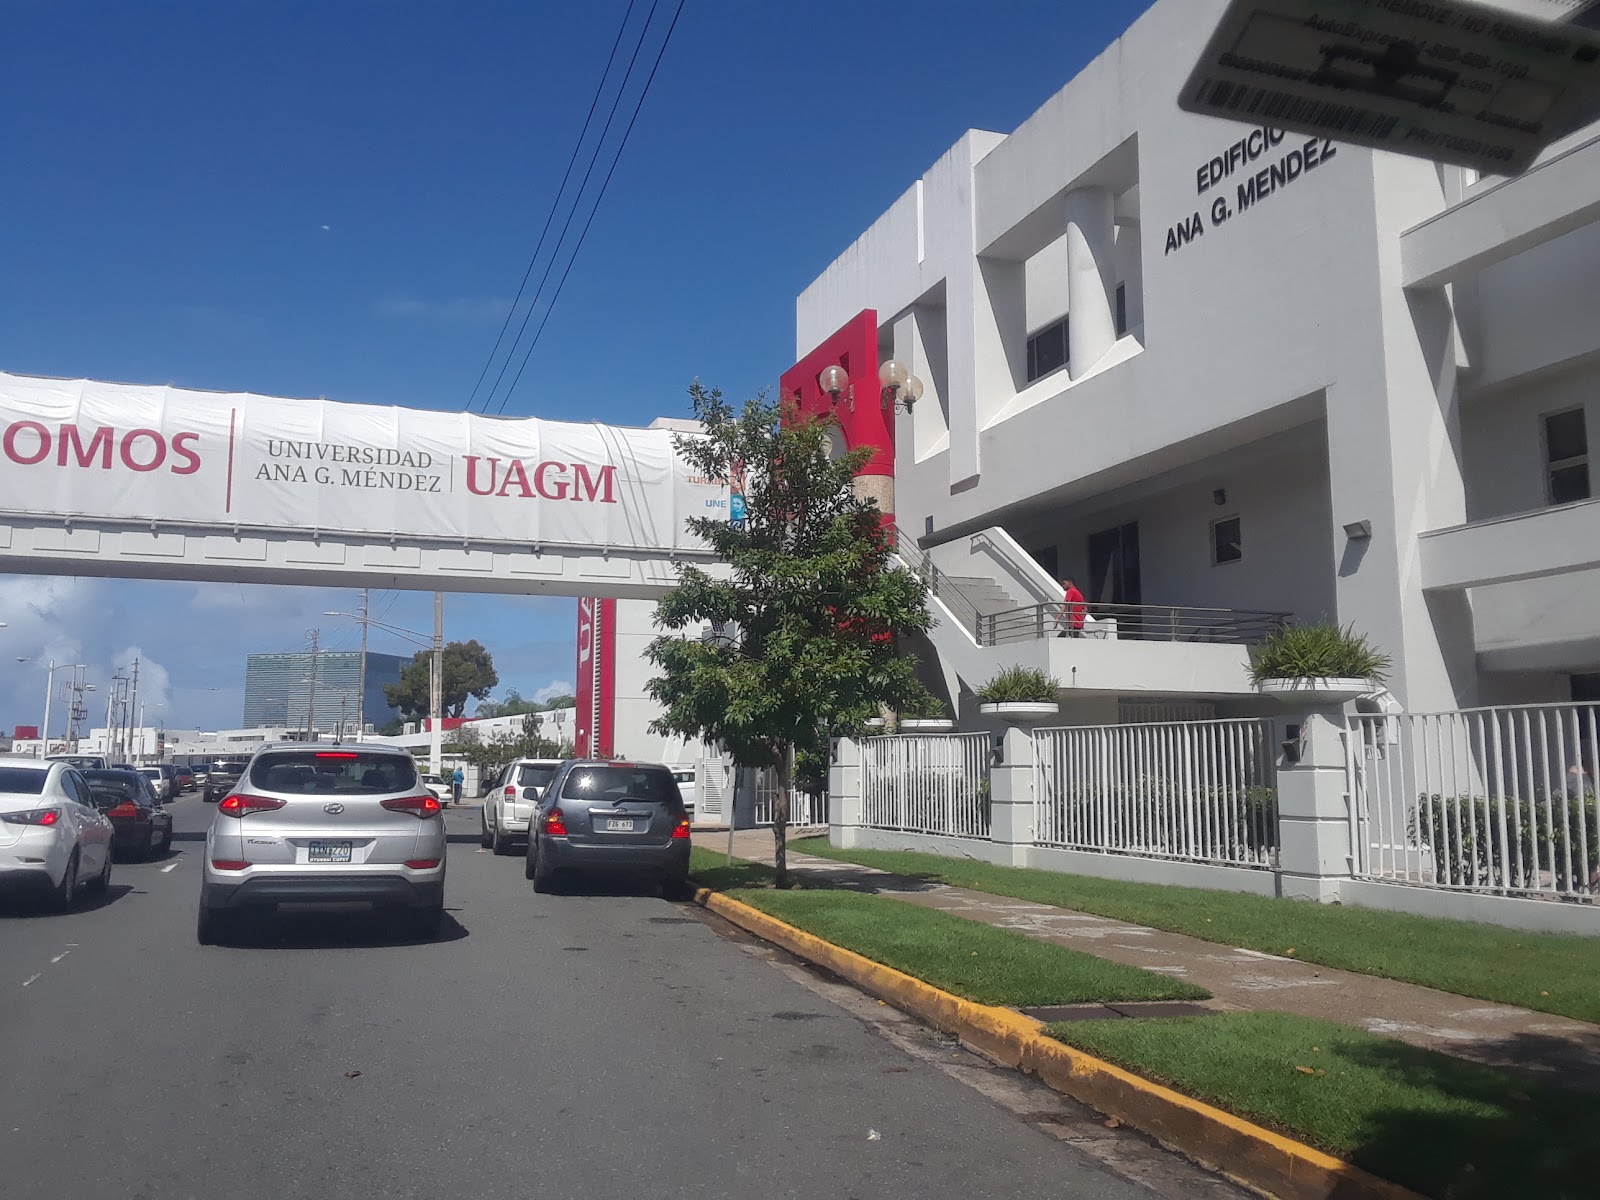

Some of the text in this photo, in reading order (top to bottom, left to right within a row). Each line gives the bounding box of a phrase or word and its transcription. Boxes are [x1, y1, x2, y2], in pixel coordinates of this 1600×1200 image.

[1197, 126, 1286, 195] EDIFICIO
[1165, 137, 1337, 256] ANA G. MENDEZ
[3, 420, 201, 475] OMOS
[267, 440, 432, 468] UNIVERSIDAD
[255, 463, 441, 492] ANA G. MÉNDEZ
[462, 455, 617, 503] UAGM
[687, 475, 725, 486] TURAB
[705, 499, 727, 508] UNE
